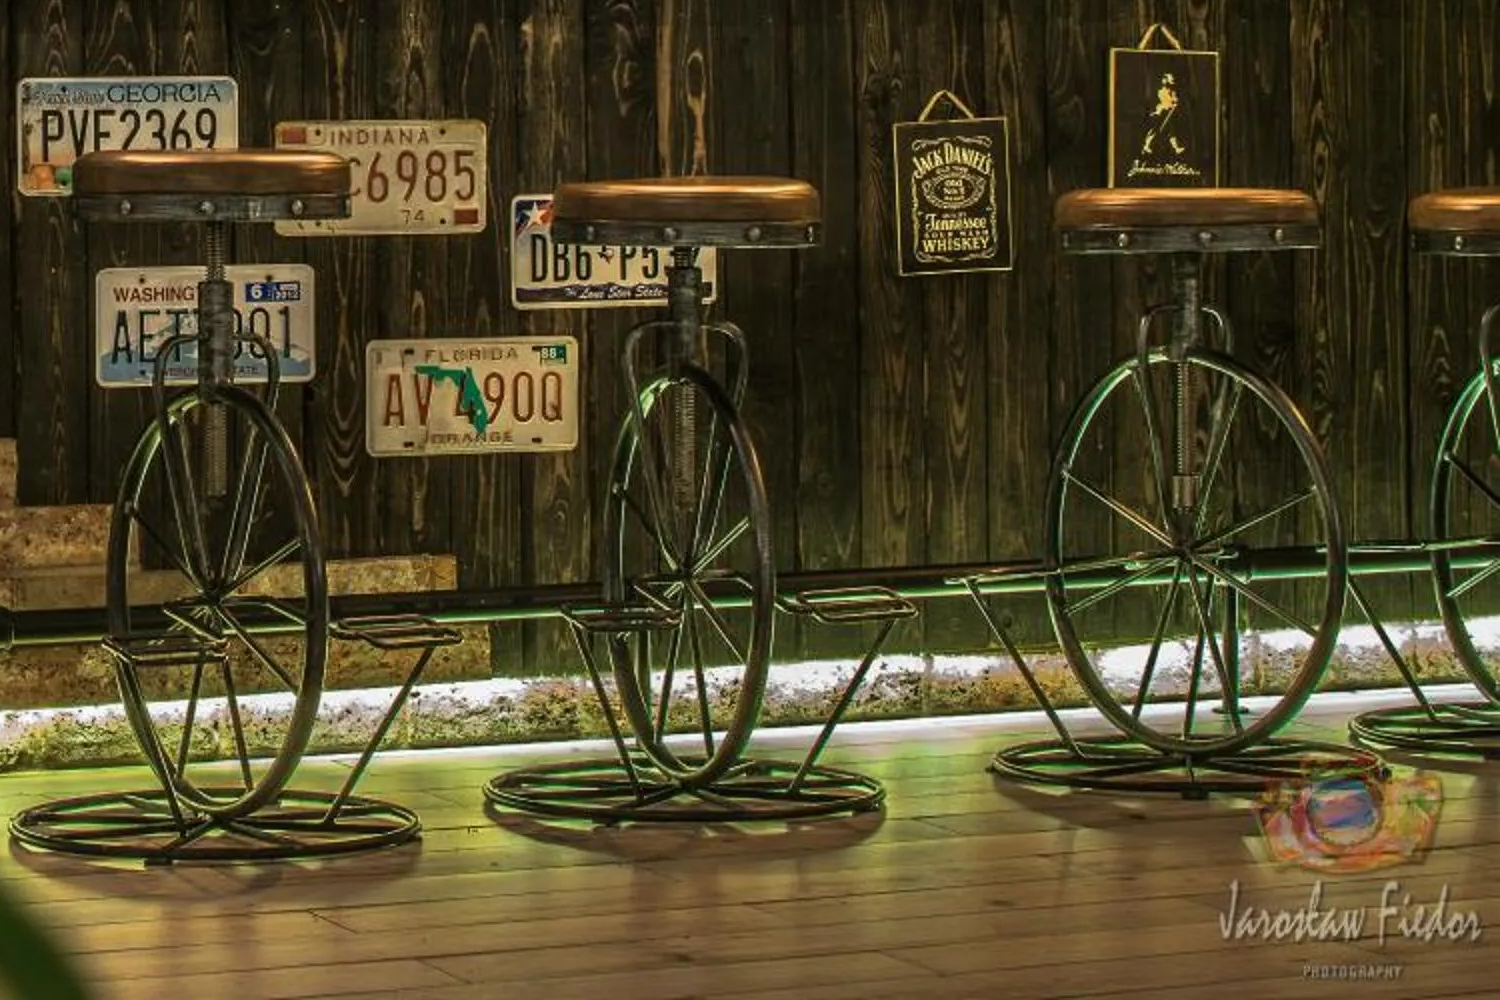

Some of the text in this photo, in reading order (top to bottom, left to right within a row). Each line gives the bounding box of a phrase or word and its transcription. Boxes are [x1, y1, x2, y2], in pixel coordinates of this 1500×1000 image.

[106, 82, 221, 104] GEORGIA
[330, 127, 430, 147] INDIANA
[912, 148, 942, 179] JACK
[401, 209, 425, 225] 74
[925, 212, 988, 232] Tennessee
[921, 235, 990, 253] WHISKEY
[251, 285, 263, 300] 6
[424, 346, 519, 363] FLORIDA
[430, 431, 514, 445] ORANGE
